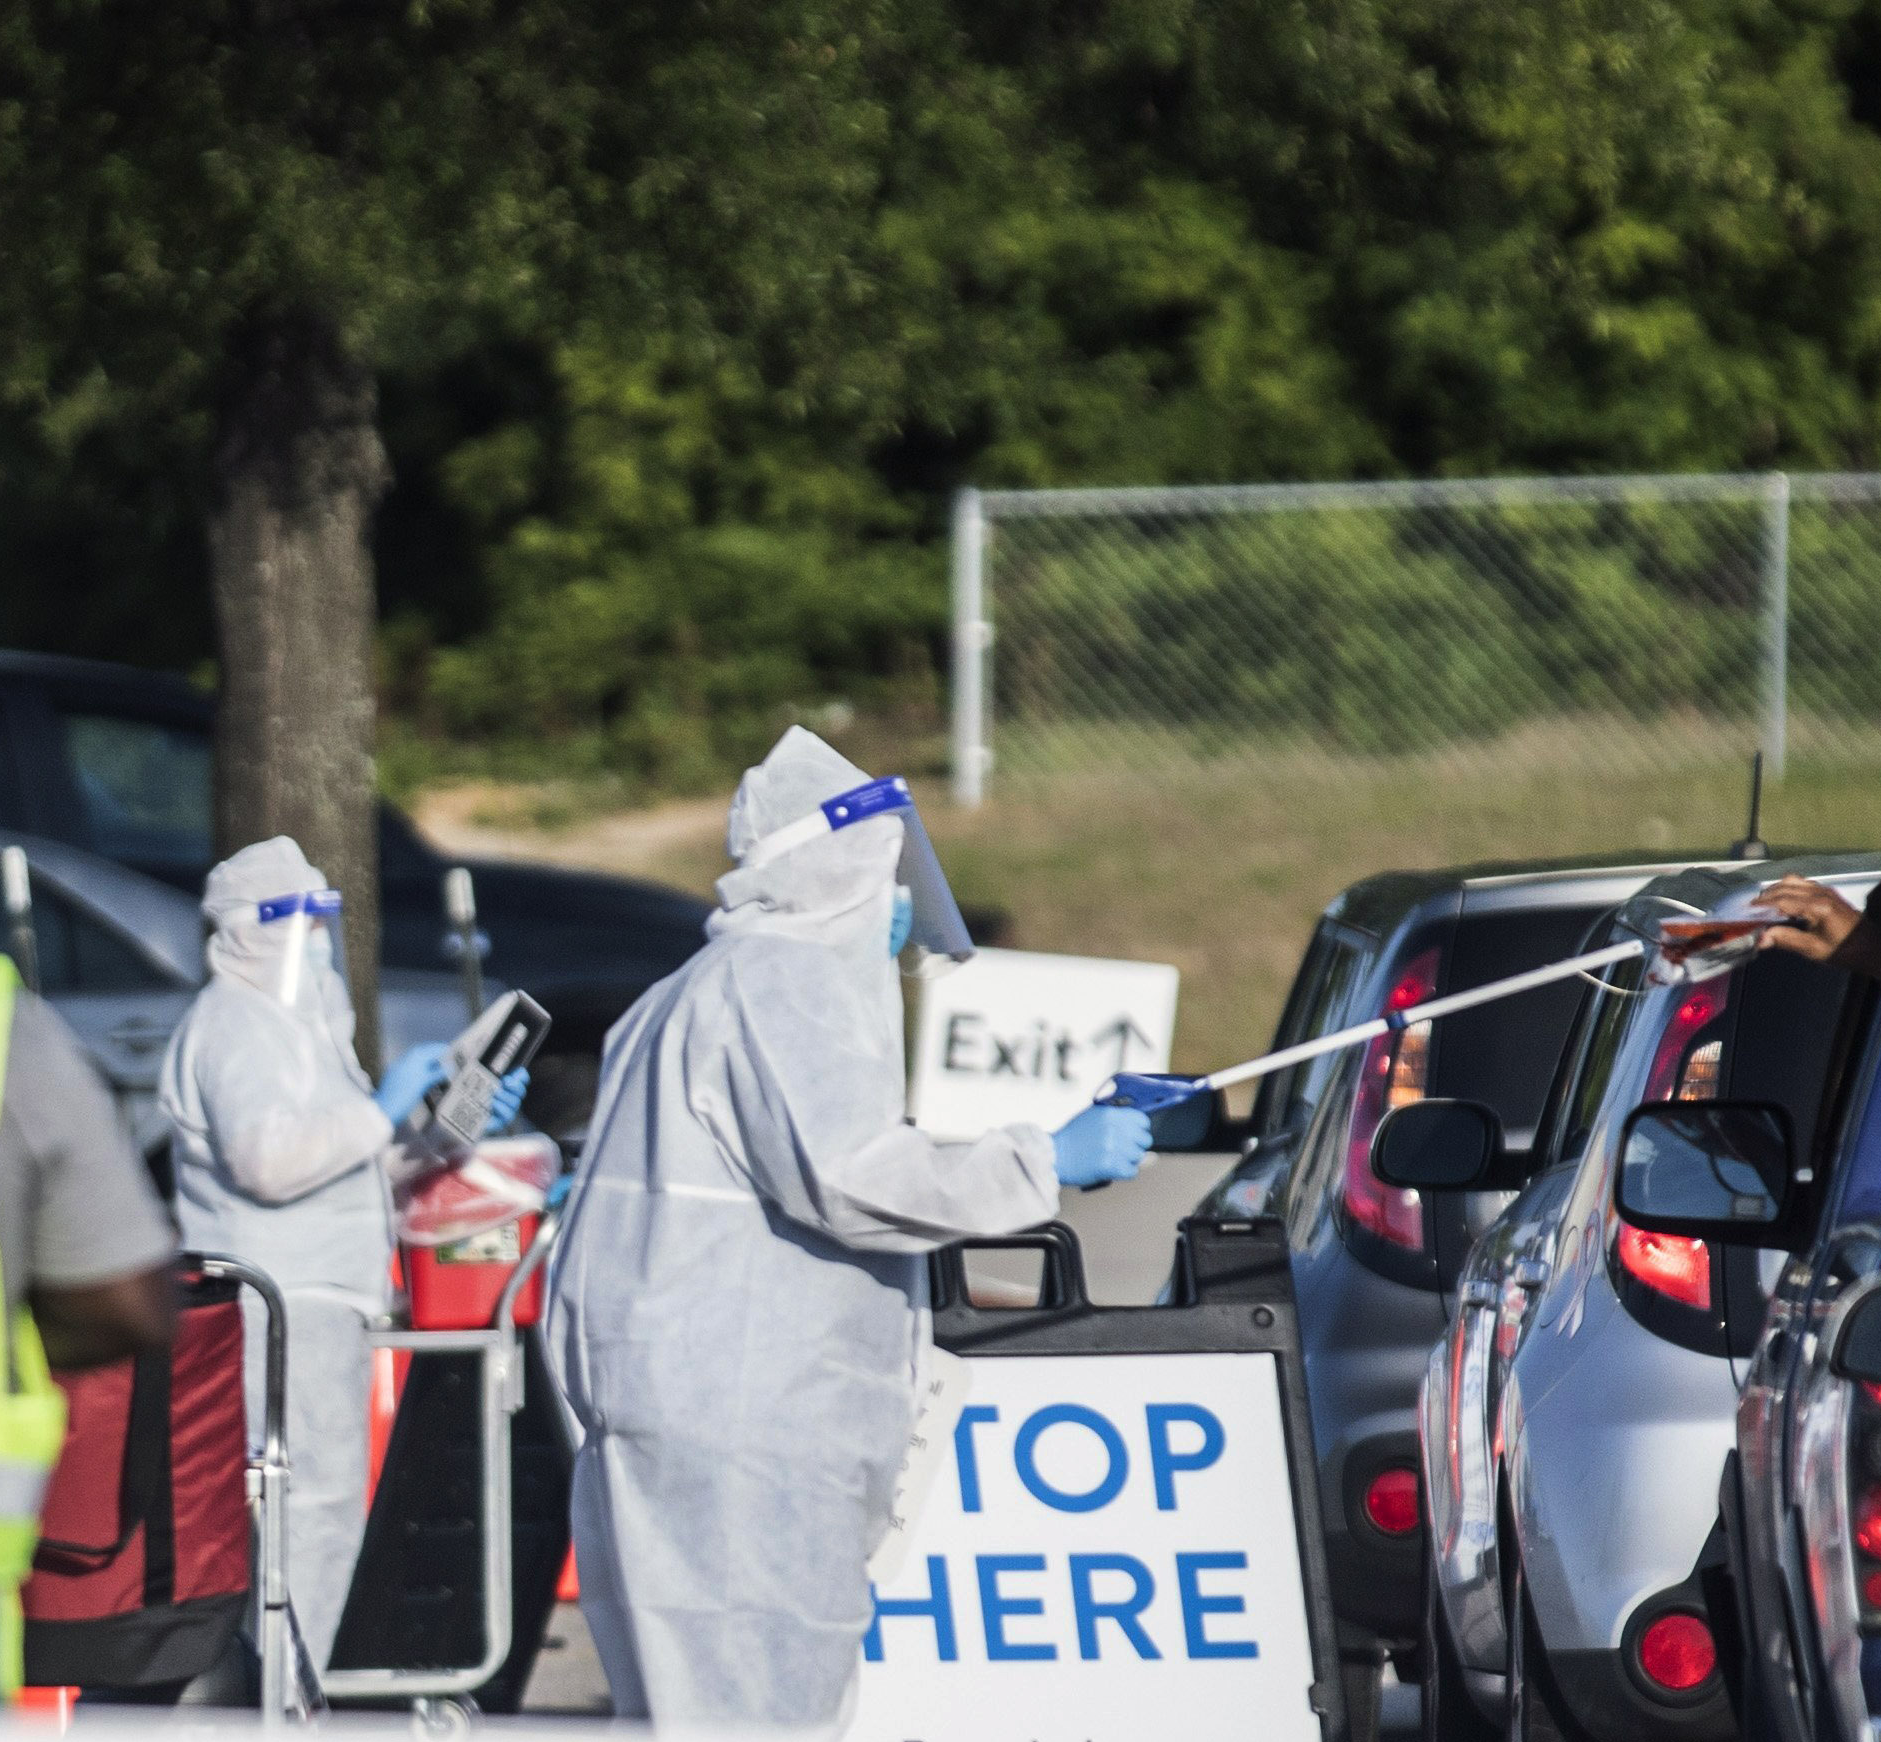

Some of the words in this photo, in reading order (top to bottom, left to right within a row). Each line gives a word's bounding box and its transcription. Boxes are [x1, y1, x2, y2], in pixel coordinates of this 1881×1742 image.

[943, 1009, 1081, 1082] Exit
[953, 1402, 1227, 1514] TOP
[863, 1552, 1260, 1662] HERE
